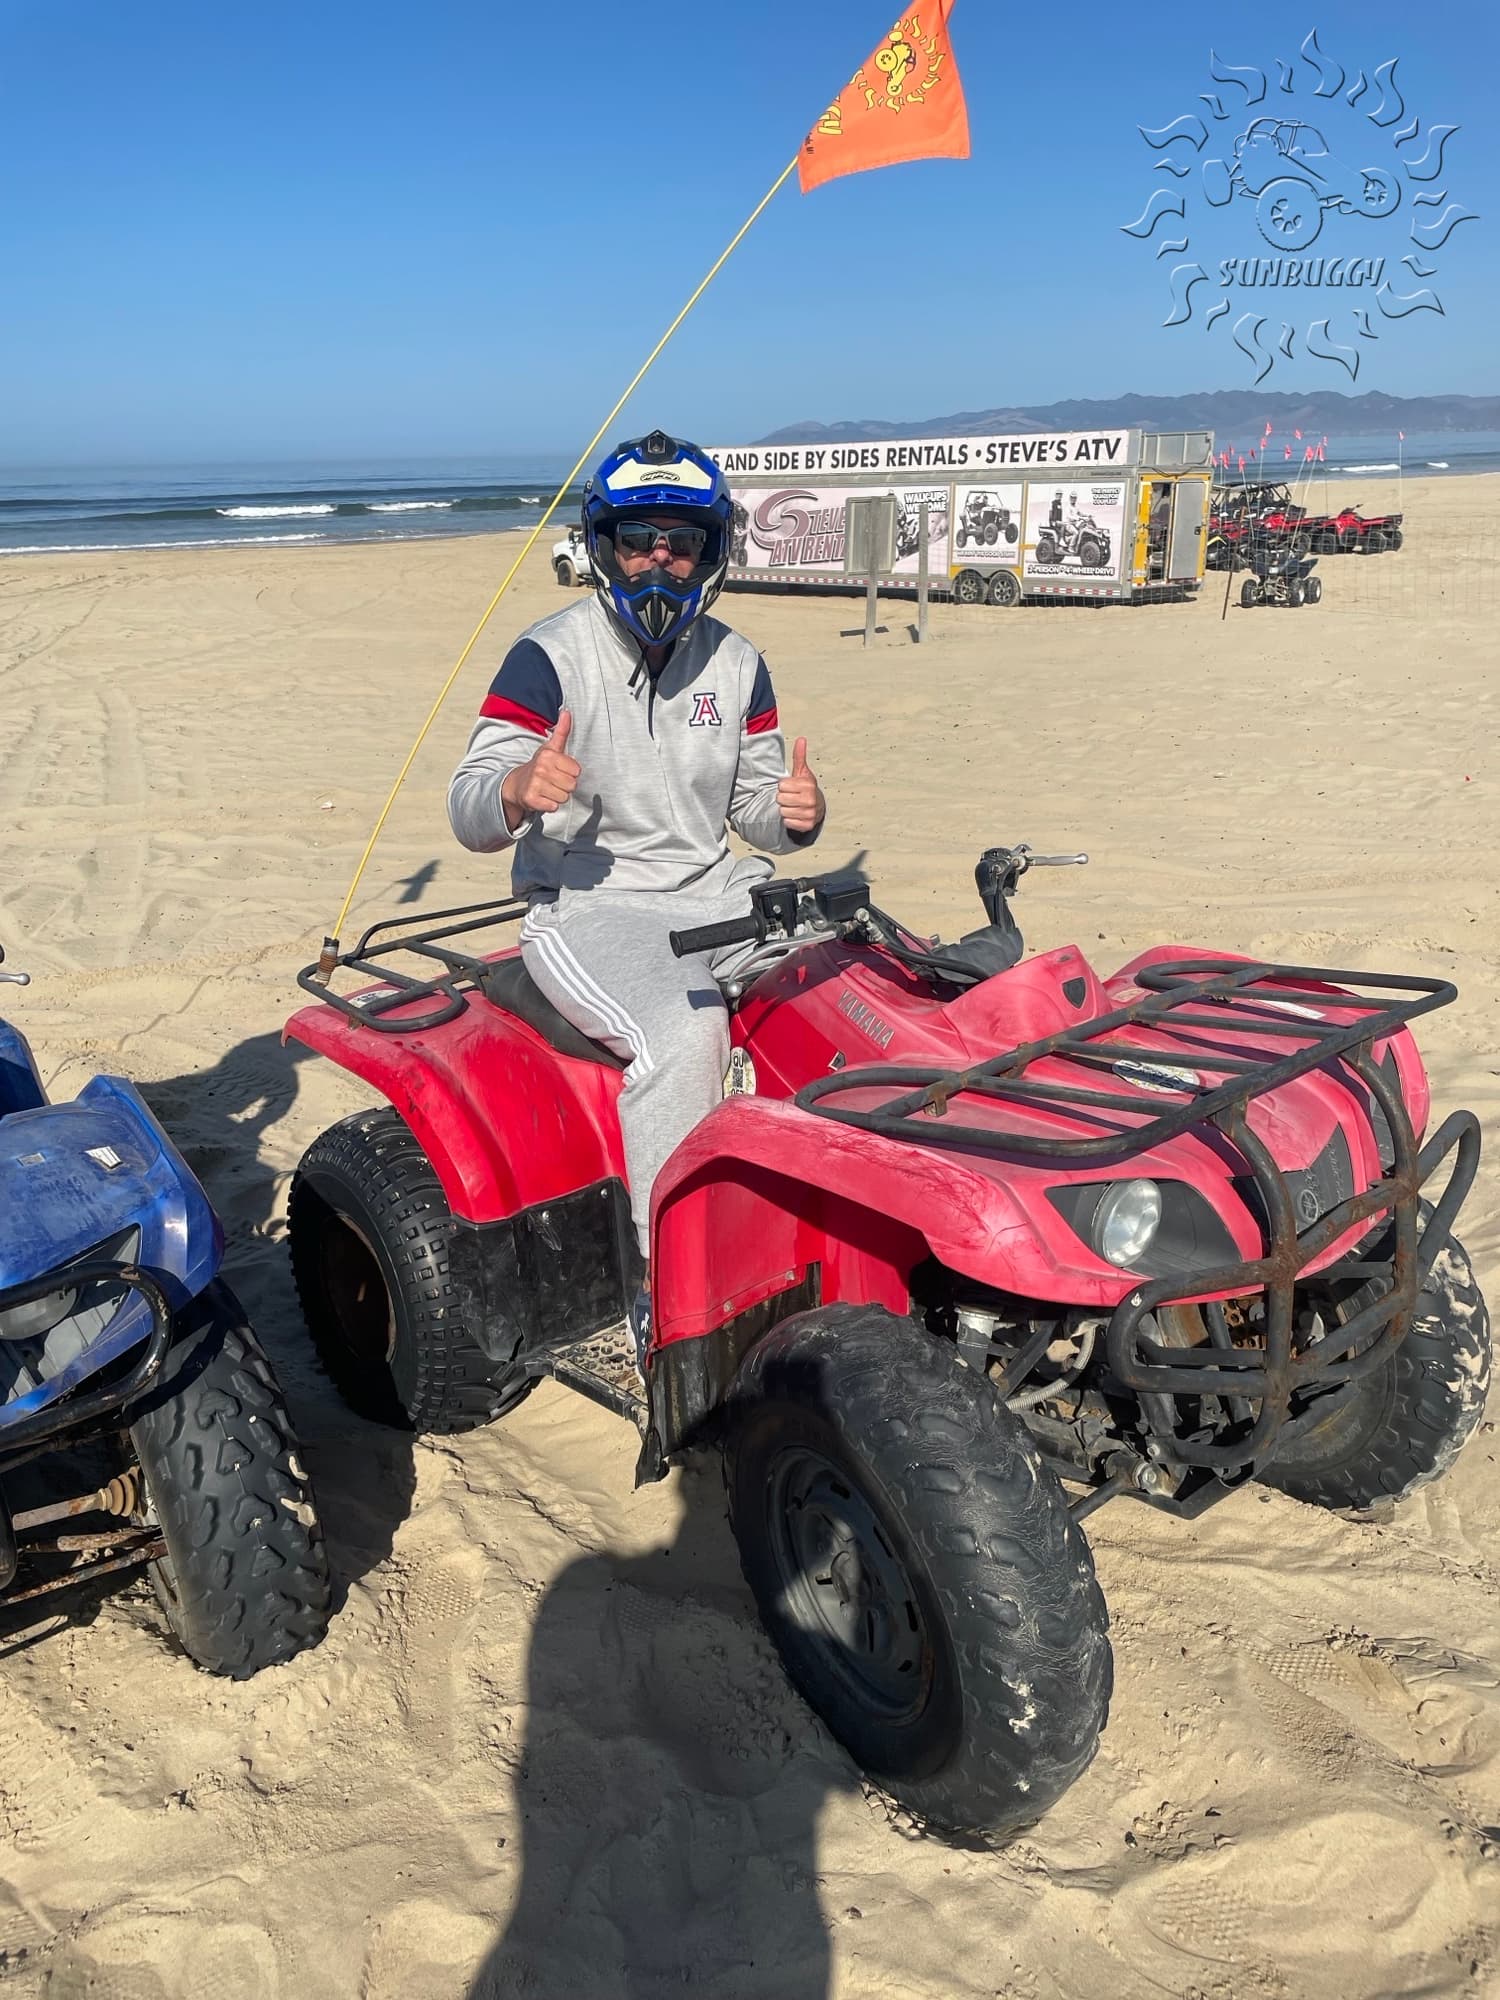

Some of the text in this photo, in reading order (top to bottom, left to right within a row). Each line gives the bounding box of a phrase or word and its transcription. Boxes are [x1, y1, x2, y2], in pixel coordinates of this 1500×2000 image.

[724, 453, 759, 472] AND
[764, 451, 799, 470] SIDE
[805, 450, 827, 469] BY
[830, 447, 880, 468] SIDES
[886, 443, 968, 467] RENTALS
[985, 439, 1068, 464] STEVE'S
[1074, 437, 1122, 461] ATV
[905, 501, 947, 514] WEOME
[768, 533, 846, 567] ATV RENT
[688, 692, 722, 727] A
[838, 989, 895, 1050] YAMAHA
